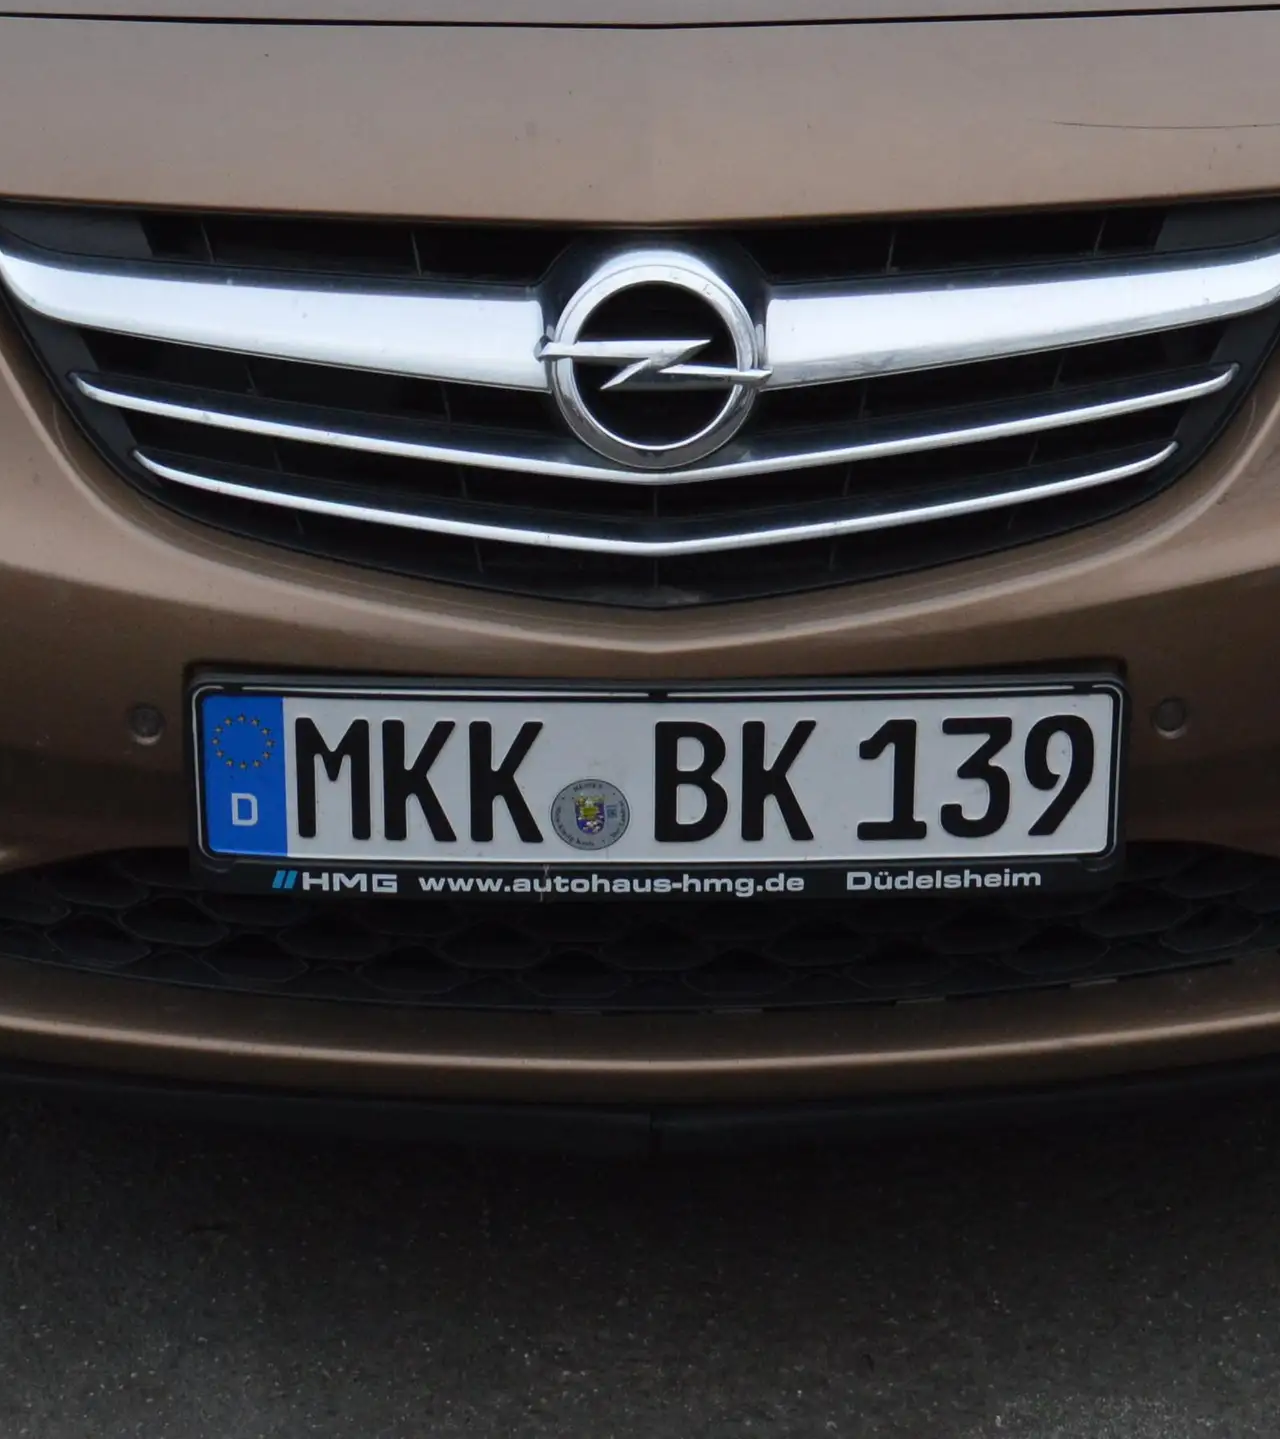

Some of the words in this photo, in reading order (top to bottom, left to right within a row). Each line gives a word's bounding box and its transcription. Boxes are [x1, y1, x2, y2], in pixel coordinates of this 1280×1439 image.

[295, 716, 544, 844] MKK
[654, 720, 817, 843] BK
[857, 714, 1095, 841] 139
[231, 792, 259, 827] D
[418, 872, 805, 898] www.autohaus-hmg.de
[846, 867, 1042, 892] Düdelsheim
